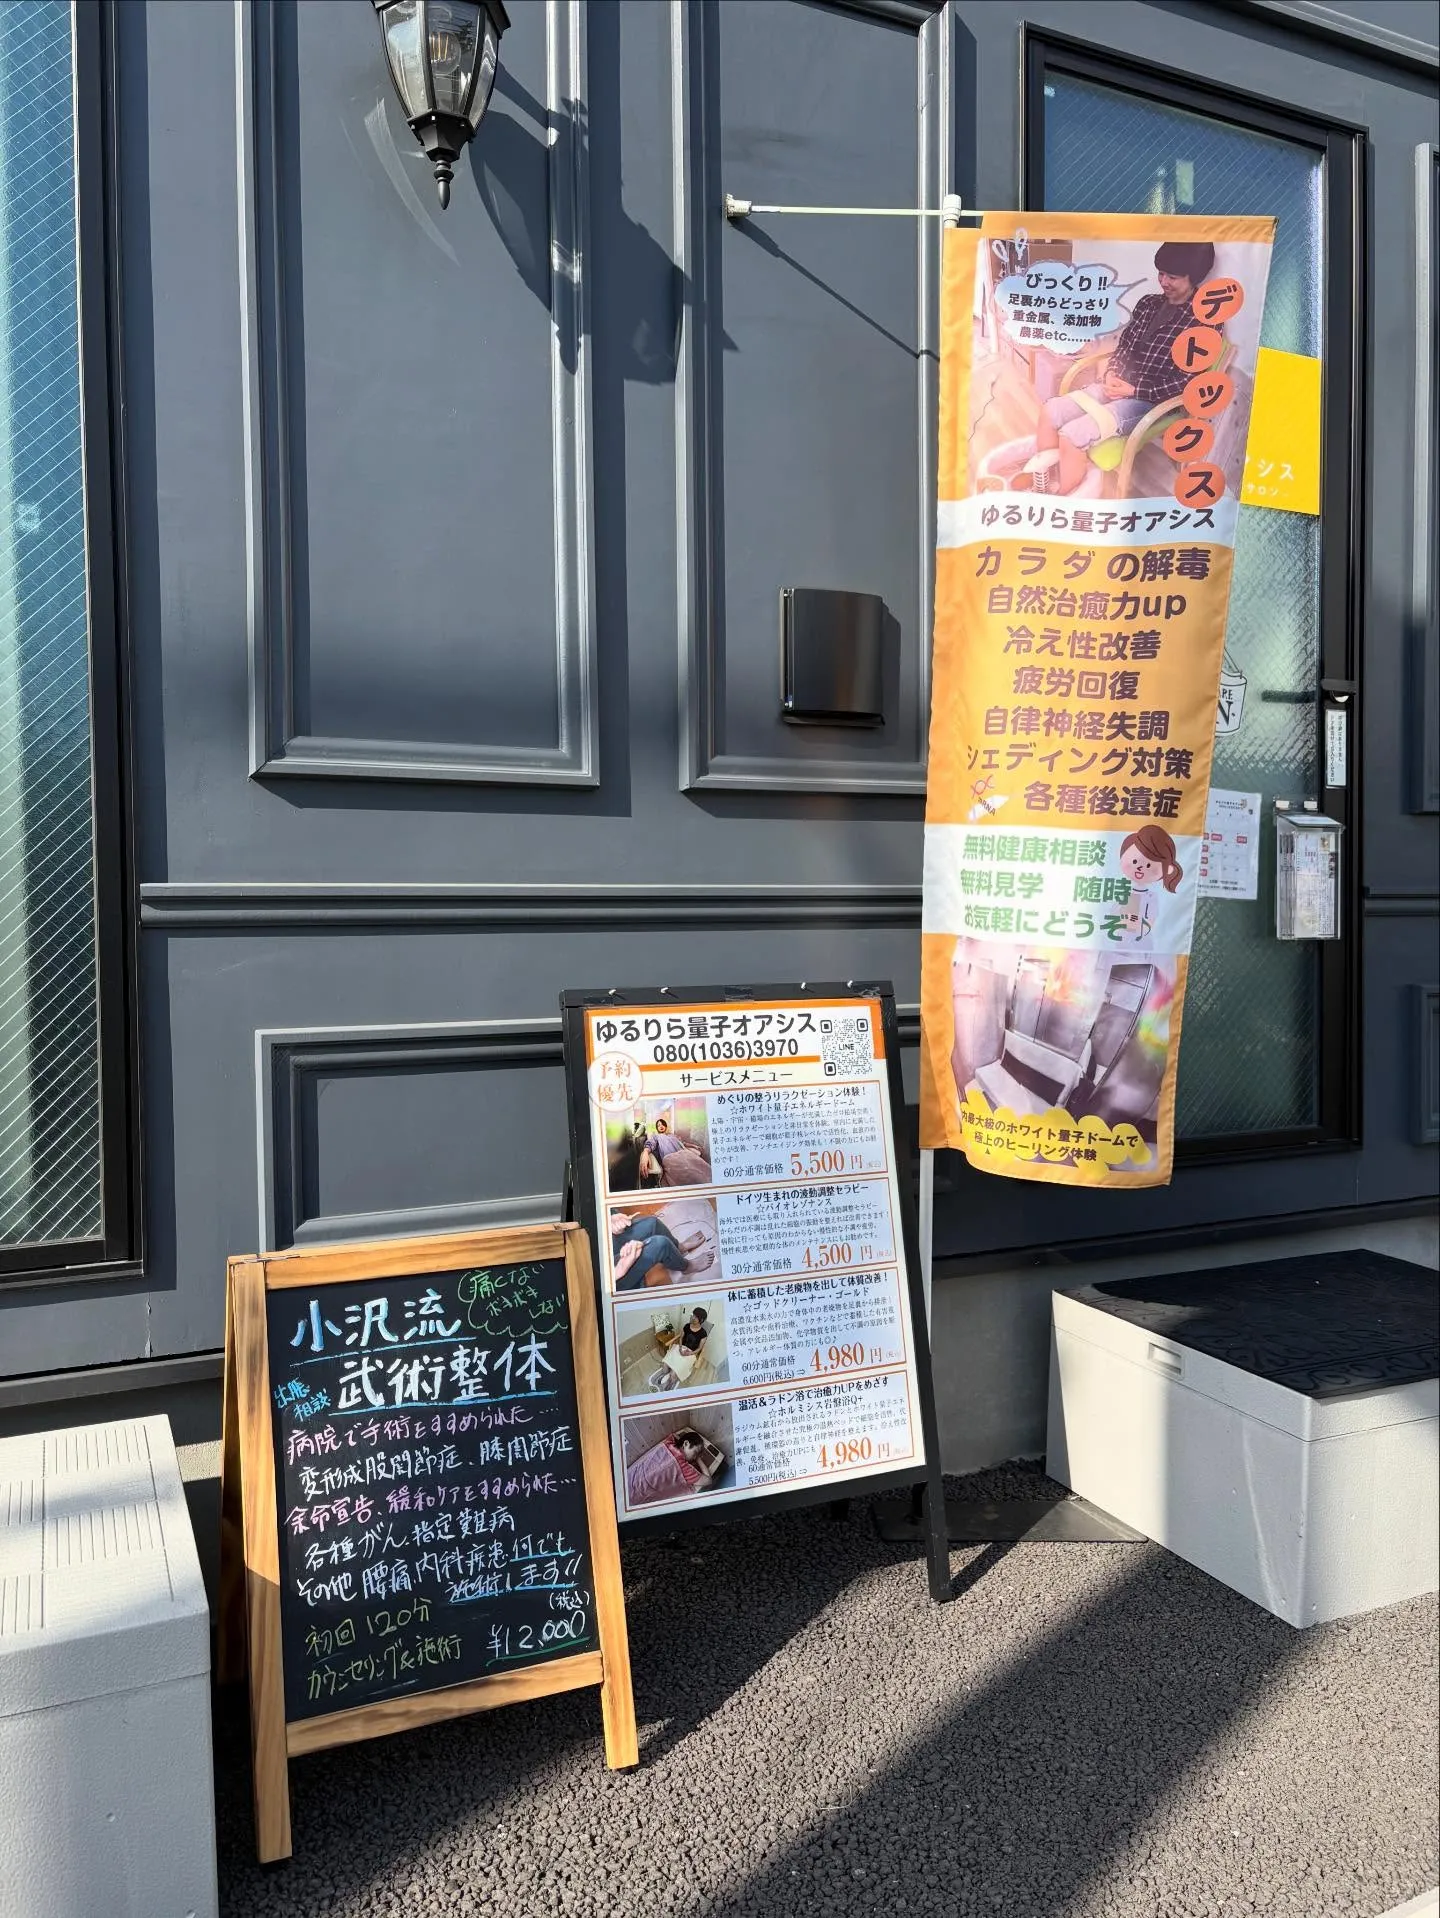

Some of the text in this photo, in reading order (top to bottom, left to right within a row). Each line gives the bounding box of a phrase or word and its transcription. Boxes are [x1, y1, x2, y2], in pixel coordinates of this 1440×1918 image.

[1008, 293, 1109, 311] 足裏からどっさり
[1012, 309, 1102, 327] 重金属、添加物
[1174, 285, 1237, 499] デトックス
[981, 505, 1215, 533] ゆるりら量子オアシス
[975, 546, 1211, 582] カラダの解毒
[987, 584, 1187, 620] 自然治癒力up
[1003, 625, 1161, 661] 冷え性改善
[1012, 665, 1140, 701] 疲労回復
[984, 706, 1170, 741] 自律神経失調
[1023, 781, 1183, 818] 各種後遺症
[962, 834, 1107, 867] 無料健康相談
[960, 869, 1132, 906] 無料見学 随時
[596, 1012, 817, 1043] ゆるりら量子オアシス
[653, 1038, 799, 1064] 080(1036)3970
[838, 1043, 855, 1051] LINE
[599, 1059, 632, 1080] 予約
[679, 1069, 793, 1088] サービスメニュー
[597, 1082, 634, 1102] 優先
[974, 1131, 1097, 1161] 極上のヒーリング体験
[723, 1162, 784, 1178] 60分通常価格
[790, 1149, 844, 1177] 5,500
[851, 1154, 863, 1170] 円
[736, 1183, 869, 1205] ドイツ生まれの波動調整セラピー
[731, 1257, 792, 1275] 30分通常価格
[802, 1242, 852, 1269] 4,500
[860, 1245, 873, 1261] 円
[290, 1288, 462, 1351] 小沢流
[338, 1333, 556, 1409] 武術整体
[741, 1355, 796, 1372] 60分通常価格
[810, 1342, 864, 1372] 4,980
[870, 1347, 882, 1363] 円
[816, 1436, 871, 1469] 4,980
[878, 1442, 890, 1459] 円
[306, 1598, 433, 1658] 初回 120分
